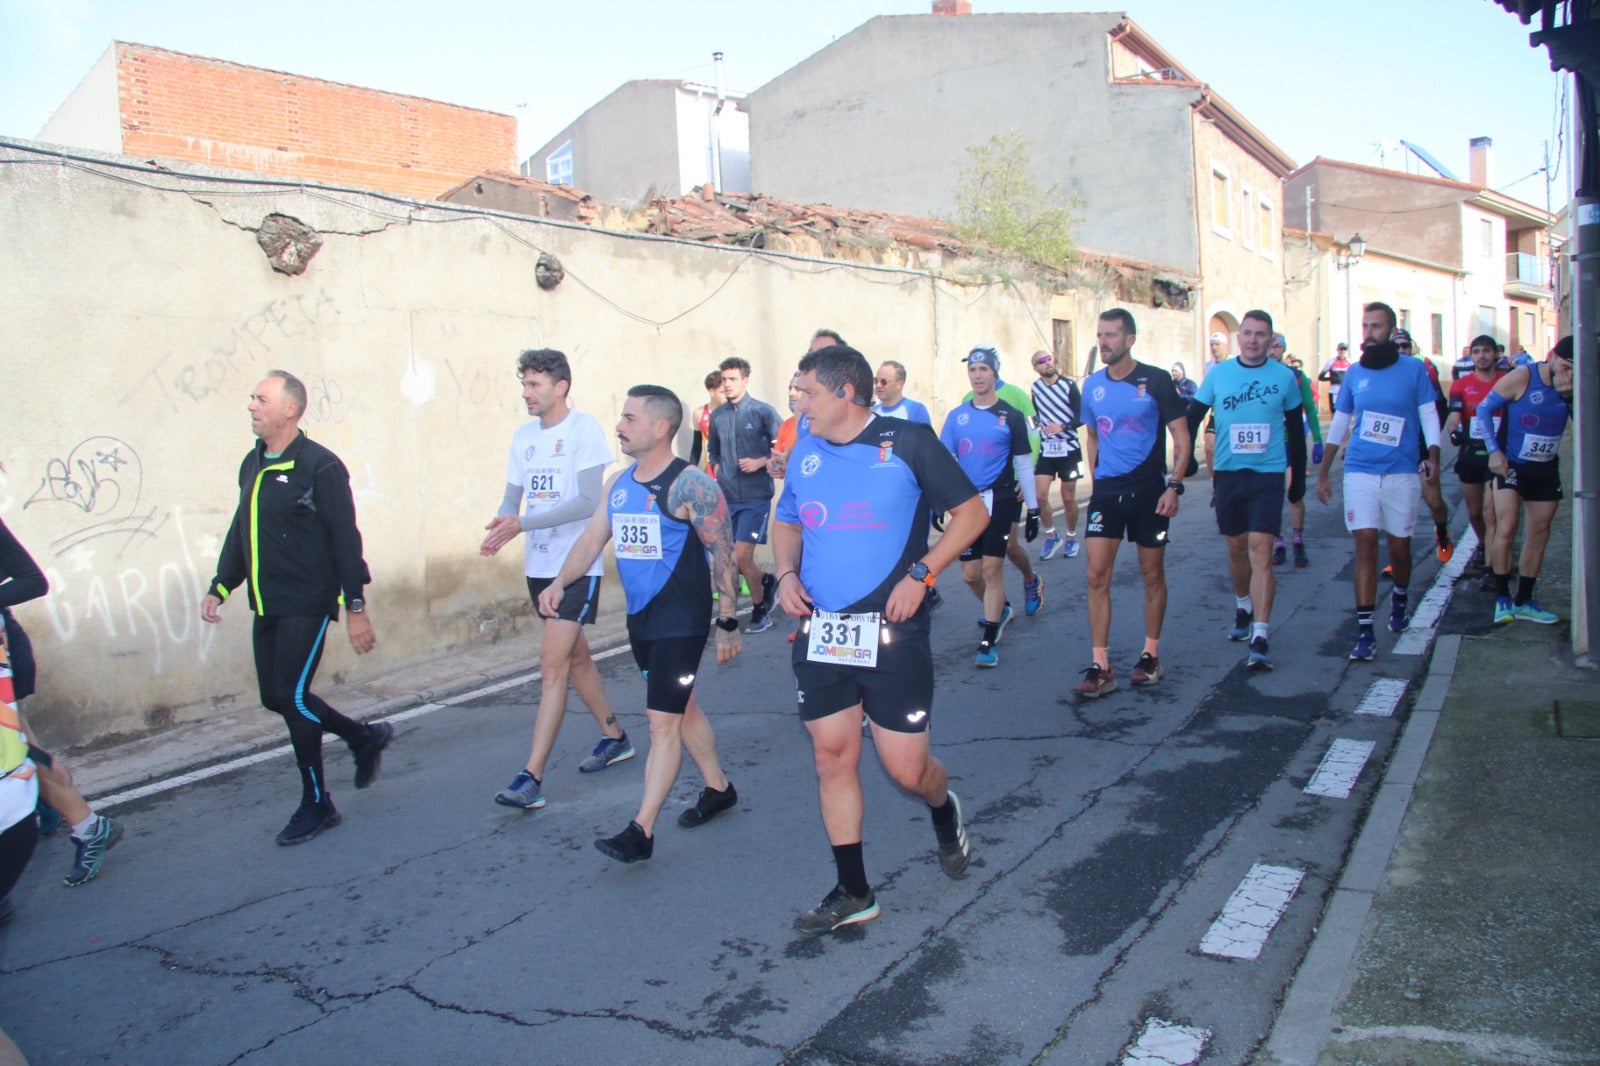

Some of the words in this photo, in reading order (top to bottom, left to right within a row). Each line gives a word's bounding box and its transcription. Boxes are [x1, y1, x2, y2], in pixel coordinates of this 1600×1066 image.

[1373, 420, 1390, 434] 89
[1238, 431, 1261, 443] 691
[1530, 442, 1554, 454] 342
[531, 475, 553, 490] 621
[621, 525, 648, 544] 335
[1088, 523, 1104, 532] MSC
[821, 622, 861, 646] 331
